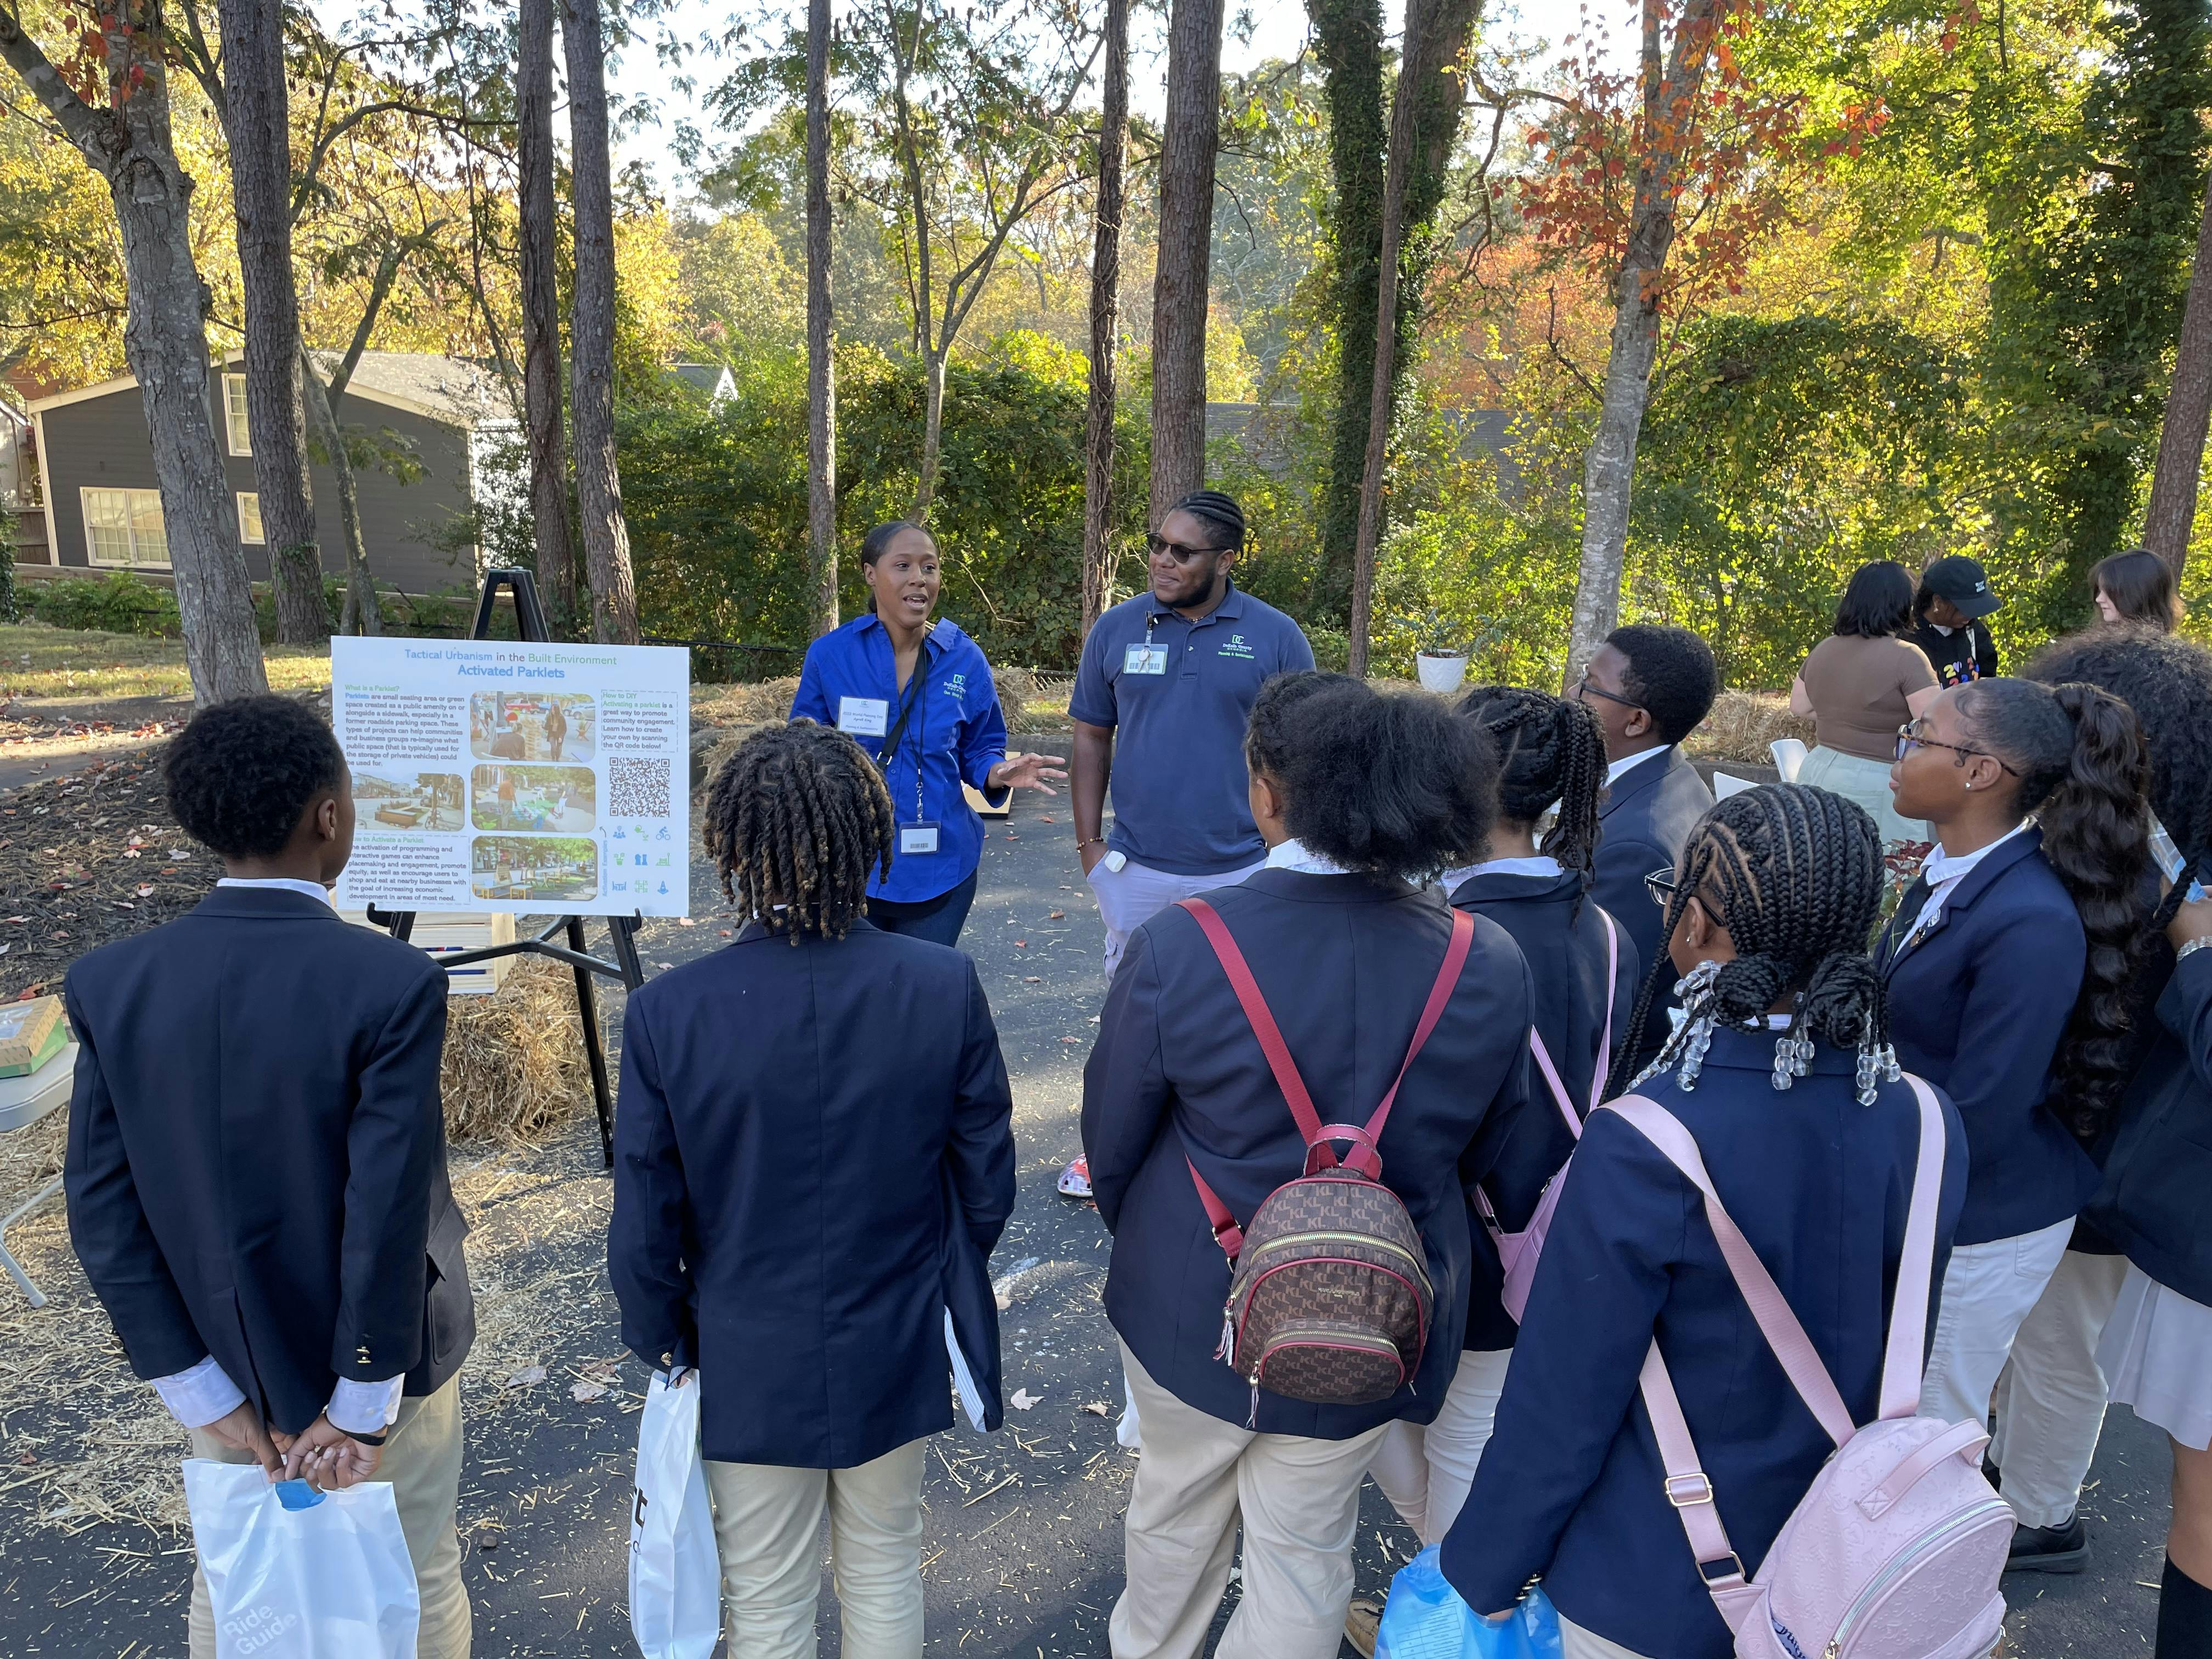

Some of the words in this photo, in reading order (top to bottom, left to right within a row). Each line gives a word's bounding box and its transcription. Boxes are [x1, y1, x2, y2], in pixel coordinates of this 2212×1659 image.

[405, 650, 442, 660] Tactical
[446, 651, 492, 661] Urbanism
[496, 652, 505, 662] in
[509, 652, 525, 662] the
[528, 653, 551, 663] Built
[555, 653, 617, 664] Environment
[458, 665, 513, 676] Activated
[517, 666, 565, 678] Parklets
[400, 695, 422, 703] seating
[423, 703, 447, 712] amenity
[603, 701, 633, 709] Activating
[346, 709, 375, 718] alongside
[411, 712, 441, 720] especially
[396, 719, 418, 727] parking
[410, 727, 423, 736] help
[408, 744, 432, 753] typically
[348, 860, 386, 868] placemaking
[348, 868, 369, 877] equity,
[349, 877, 363, 885] shop
[383, 885, 413, 894] increasing
[349, 893, 387, 901] development
[1317, 1185, 1334, 1196] KL
[223, 1606, 272, 1637] Ride
[236, 1613, 297, 1655] Guide
